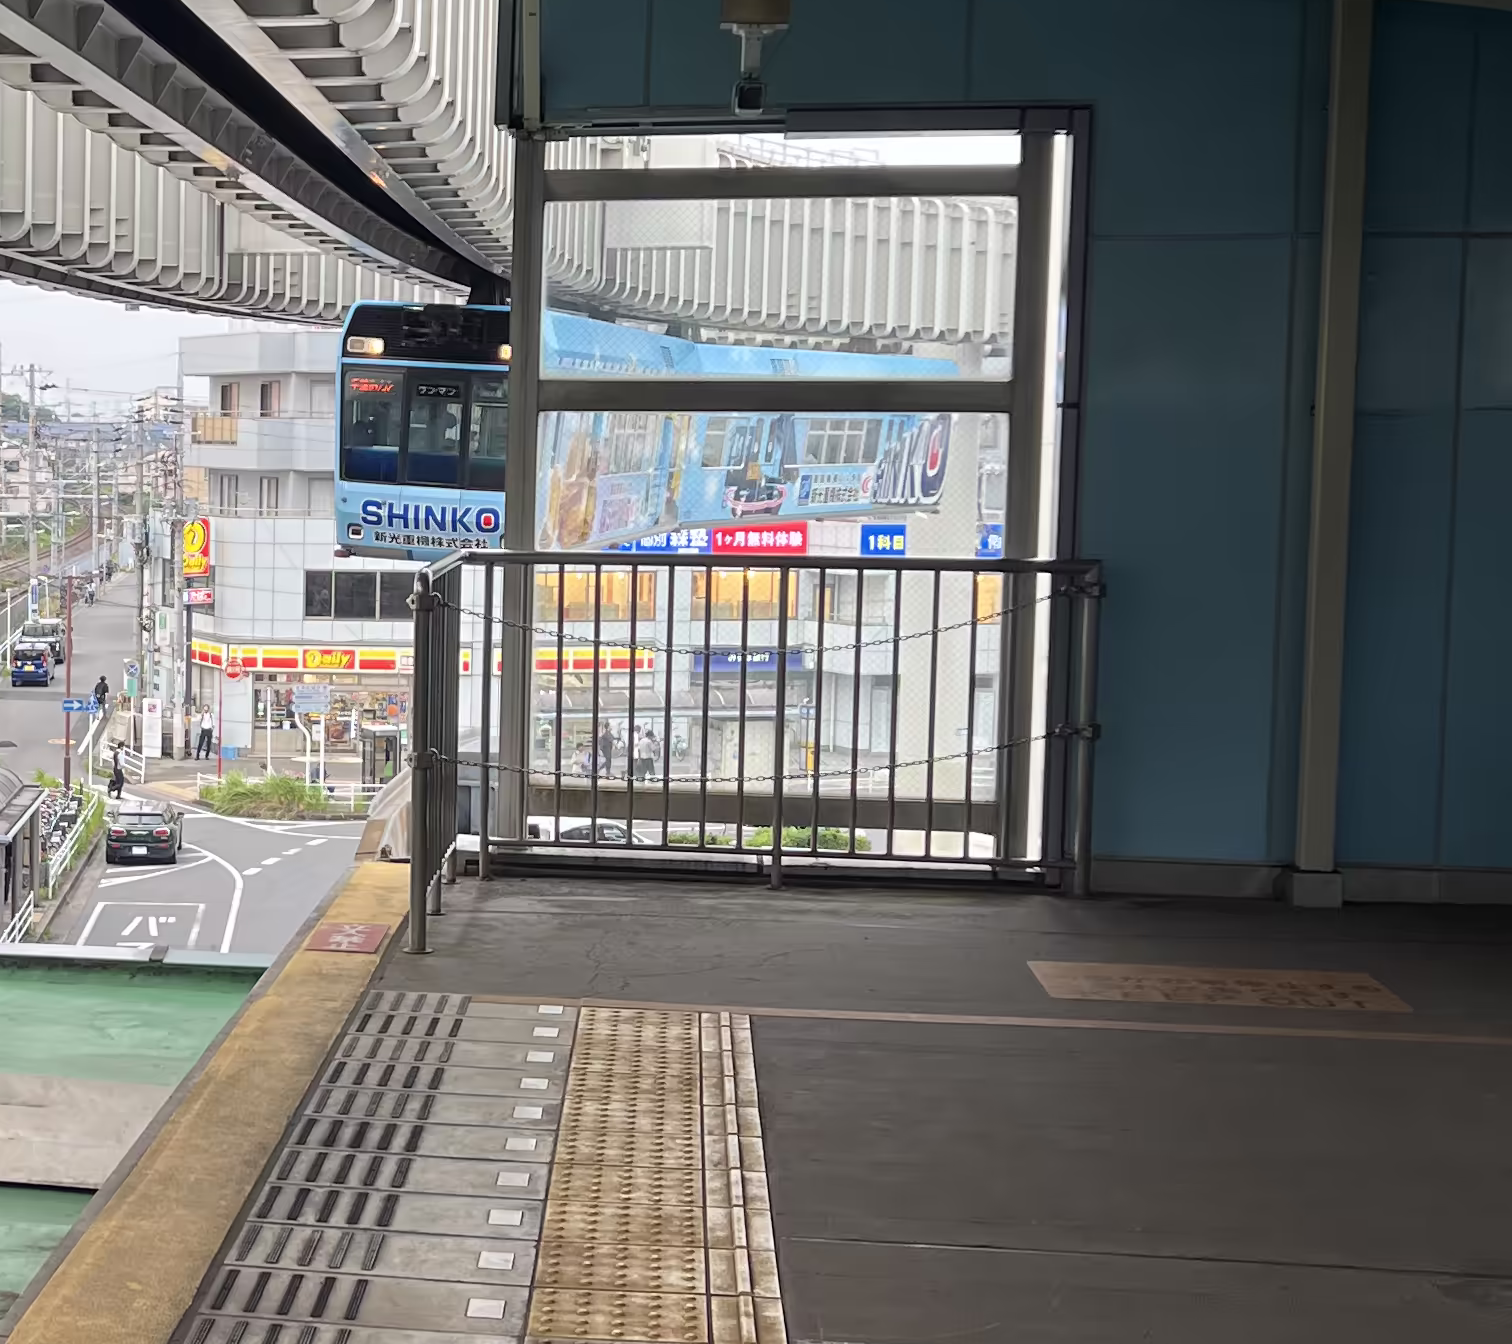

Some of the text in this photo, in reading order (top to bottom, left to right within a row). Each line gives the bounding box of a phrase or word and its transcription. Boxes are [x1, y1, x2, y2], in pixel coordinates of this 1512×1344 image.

[418, 385, 458, 396] ワンマン
[361, 499, 500, 534] SHINKO
[374, 531, 488, 549] 新光重機株式会社
[306, 650, 352, 668] Daily
